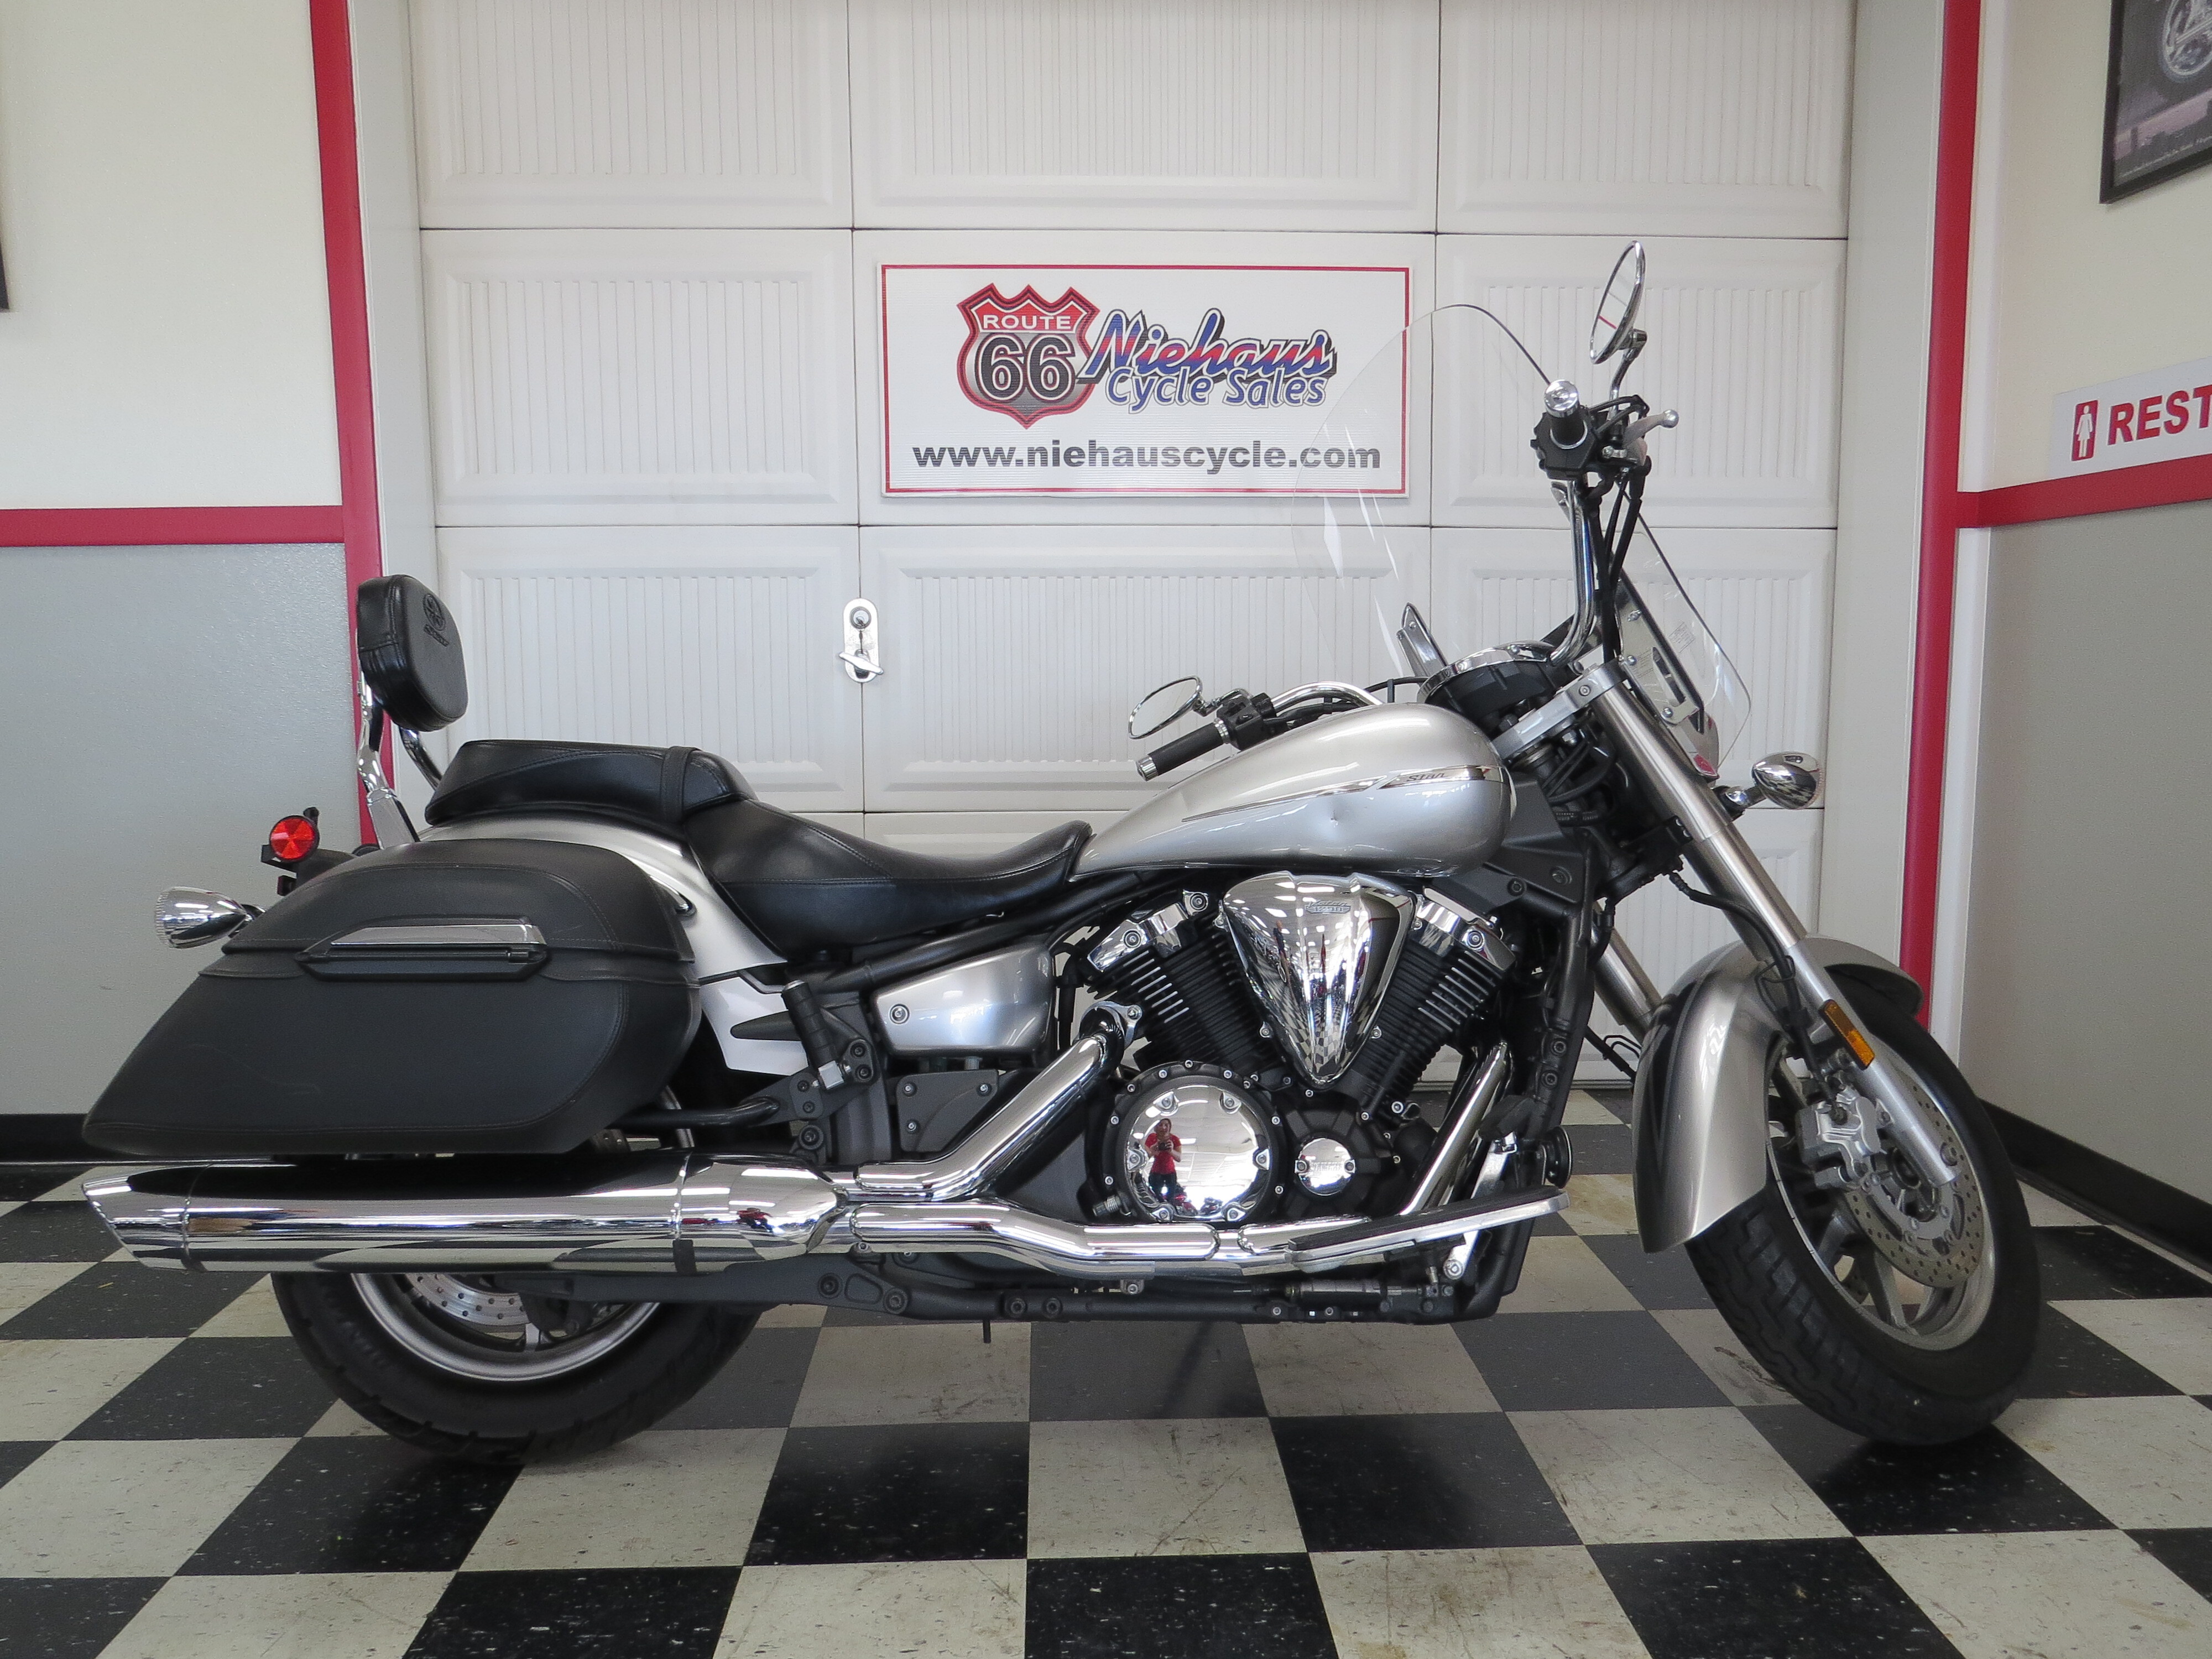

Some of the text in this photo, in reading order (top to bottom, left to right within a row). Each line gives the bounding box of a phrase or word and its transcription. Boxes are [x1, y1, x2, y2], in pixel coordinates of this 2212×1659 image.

[983, 315, 1071, 329] ROUTE
[1077, 308, 1337, 384] Niehaus
[974, 333, 1076, 403] 66
[1105, 366, 1326, 414] Cycle Sales
[2107, 383, 2212, 446] REST
[912, 440, 1380, 475] www.niehauscycle.com
